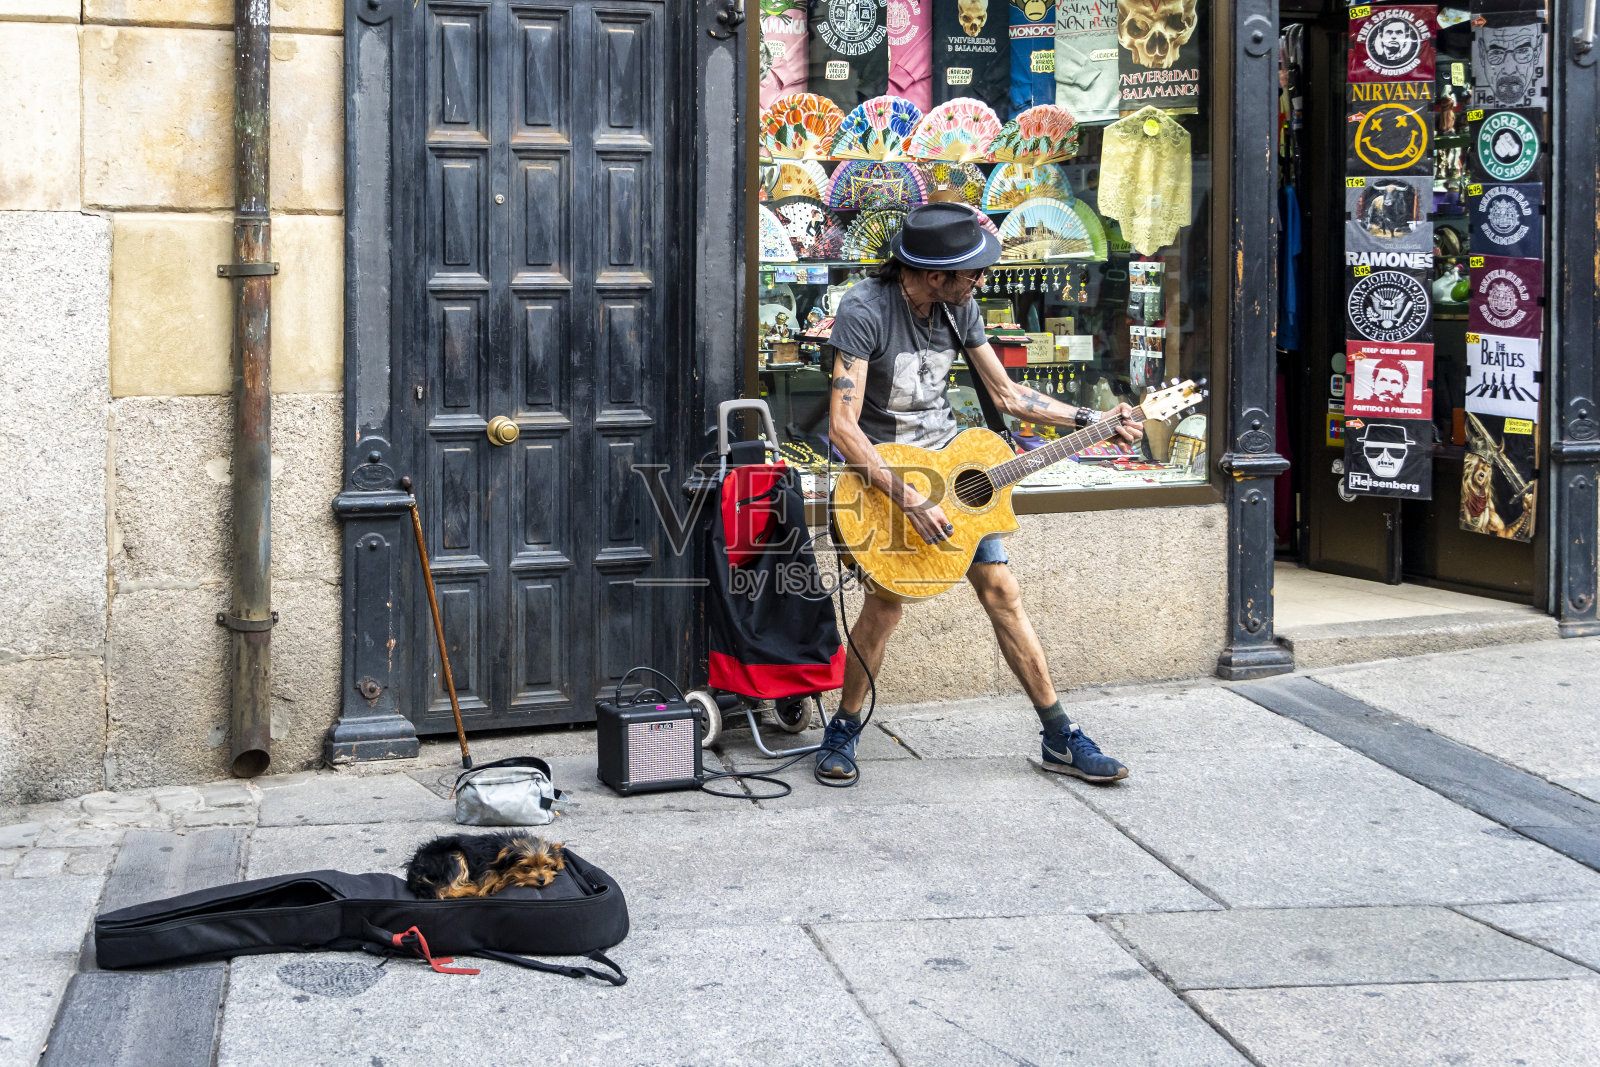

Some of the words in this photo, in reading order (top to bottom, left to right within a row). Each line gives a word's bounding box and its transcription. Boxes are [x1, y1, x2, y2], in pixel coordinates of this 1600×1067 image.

[1350, 7, 1370, 18] 8.95
[1356, 21, 1373, 42] THE
[1371, 9, 1415, 24] SPECIAL
[1414, 19, 1431, 40] ONE
[817, 21, 887, 56] SALAMANCA
[954, 45, 997, 53] SALAMANCA
[1380, 58, 1421, 76] MOURINHO
[1123, 84, 1199, 100] SALAMANCA
[1352, 83, 1432, 101] NIRVANA
[1482, 115, 1533, 142] STORBAS
[1486, 158, 1494, 166] Y
[1491, 164, 1503, 175] LO
[1504, 158, 1530, 177] SABES
[1346, 251, 1433, 269] RAMONES
[1365, 273, 1415, 288] JOHNNY
[1351, 287, 1365, 330] TOMMY
[1414, 291, 1426, 320] JOEY
[1481, 338, 1525, 371] BEATLES
[1495, 341, 1505, 351] THE
[1350, 474, 1420, 493] Heisenberg
